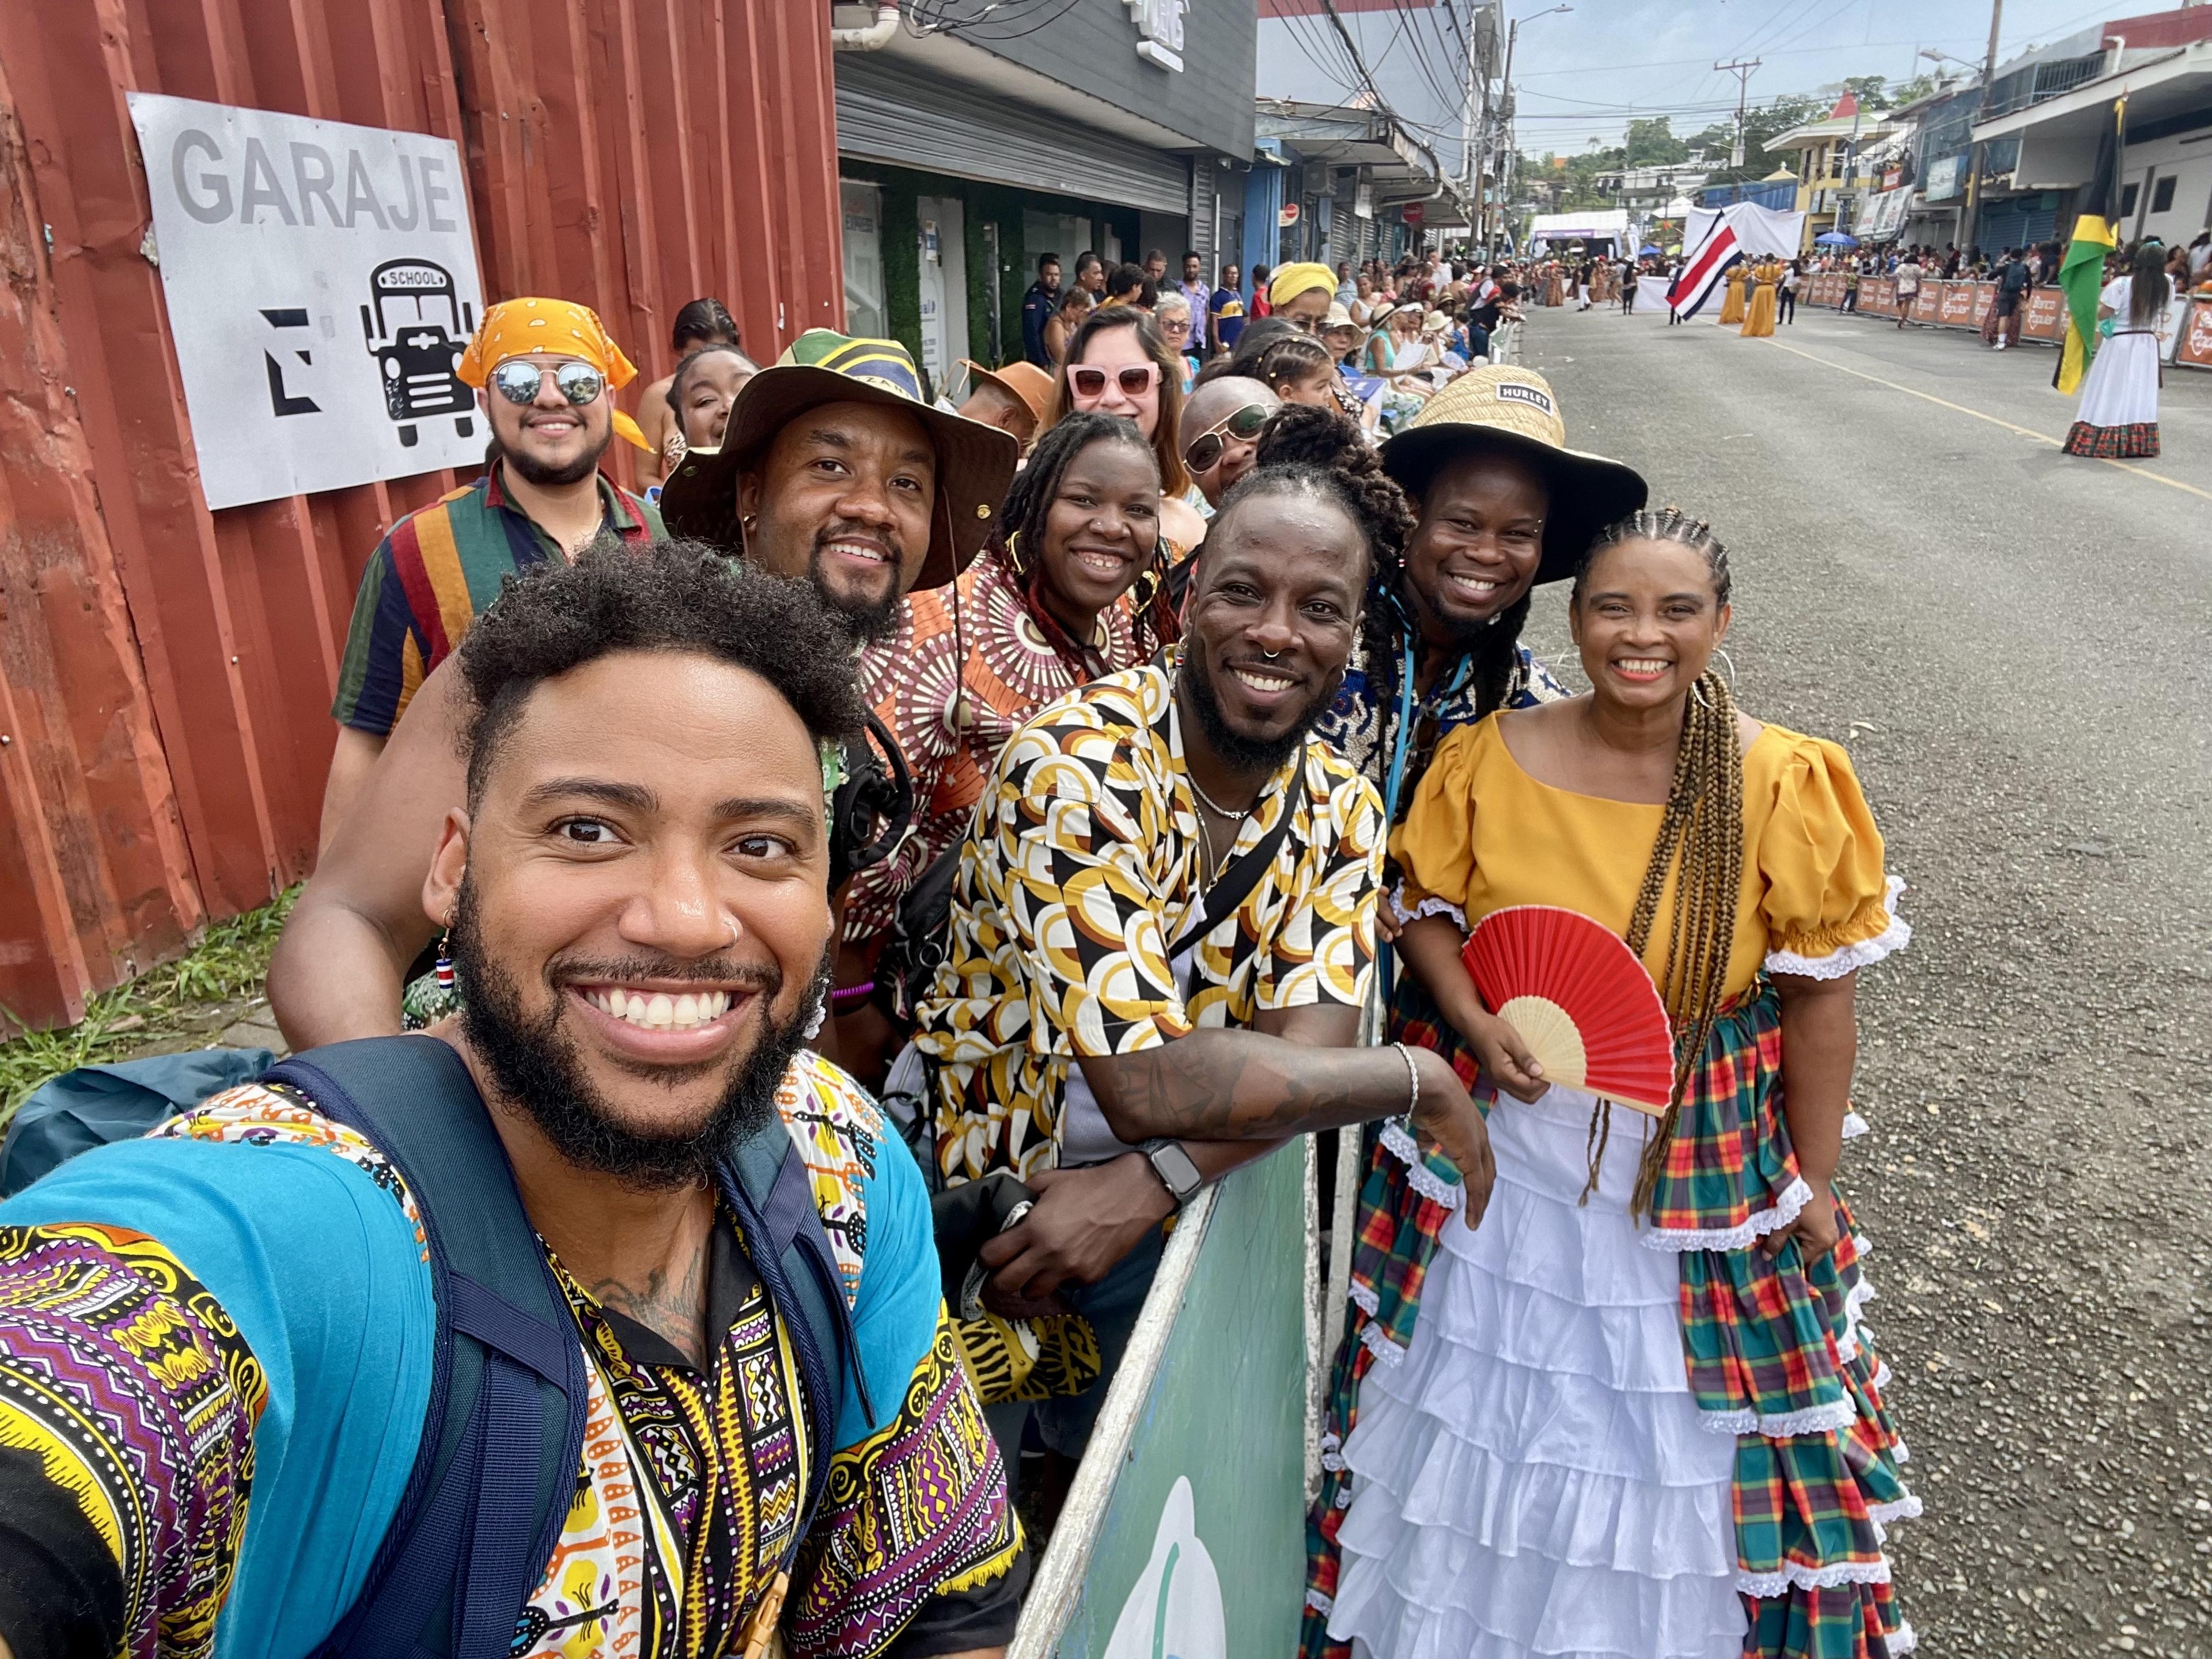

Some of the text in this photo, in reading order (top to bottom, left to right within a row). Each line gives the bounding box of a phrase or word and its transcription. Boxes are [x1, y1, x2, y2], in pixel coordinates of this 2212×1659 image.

[172, 128, 457, 232] GARAJE
[389, 271, 438, 286] SCHOOL
[857, 376, 910, 398] ZANI
[1502, 388, 1548, 407] HURLEY
